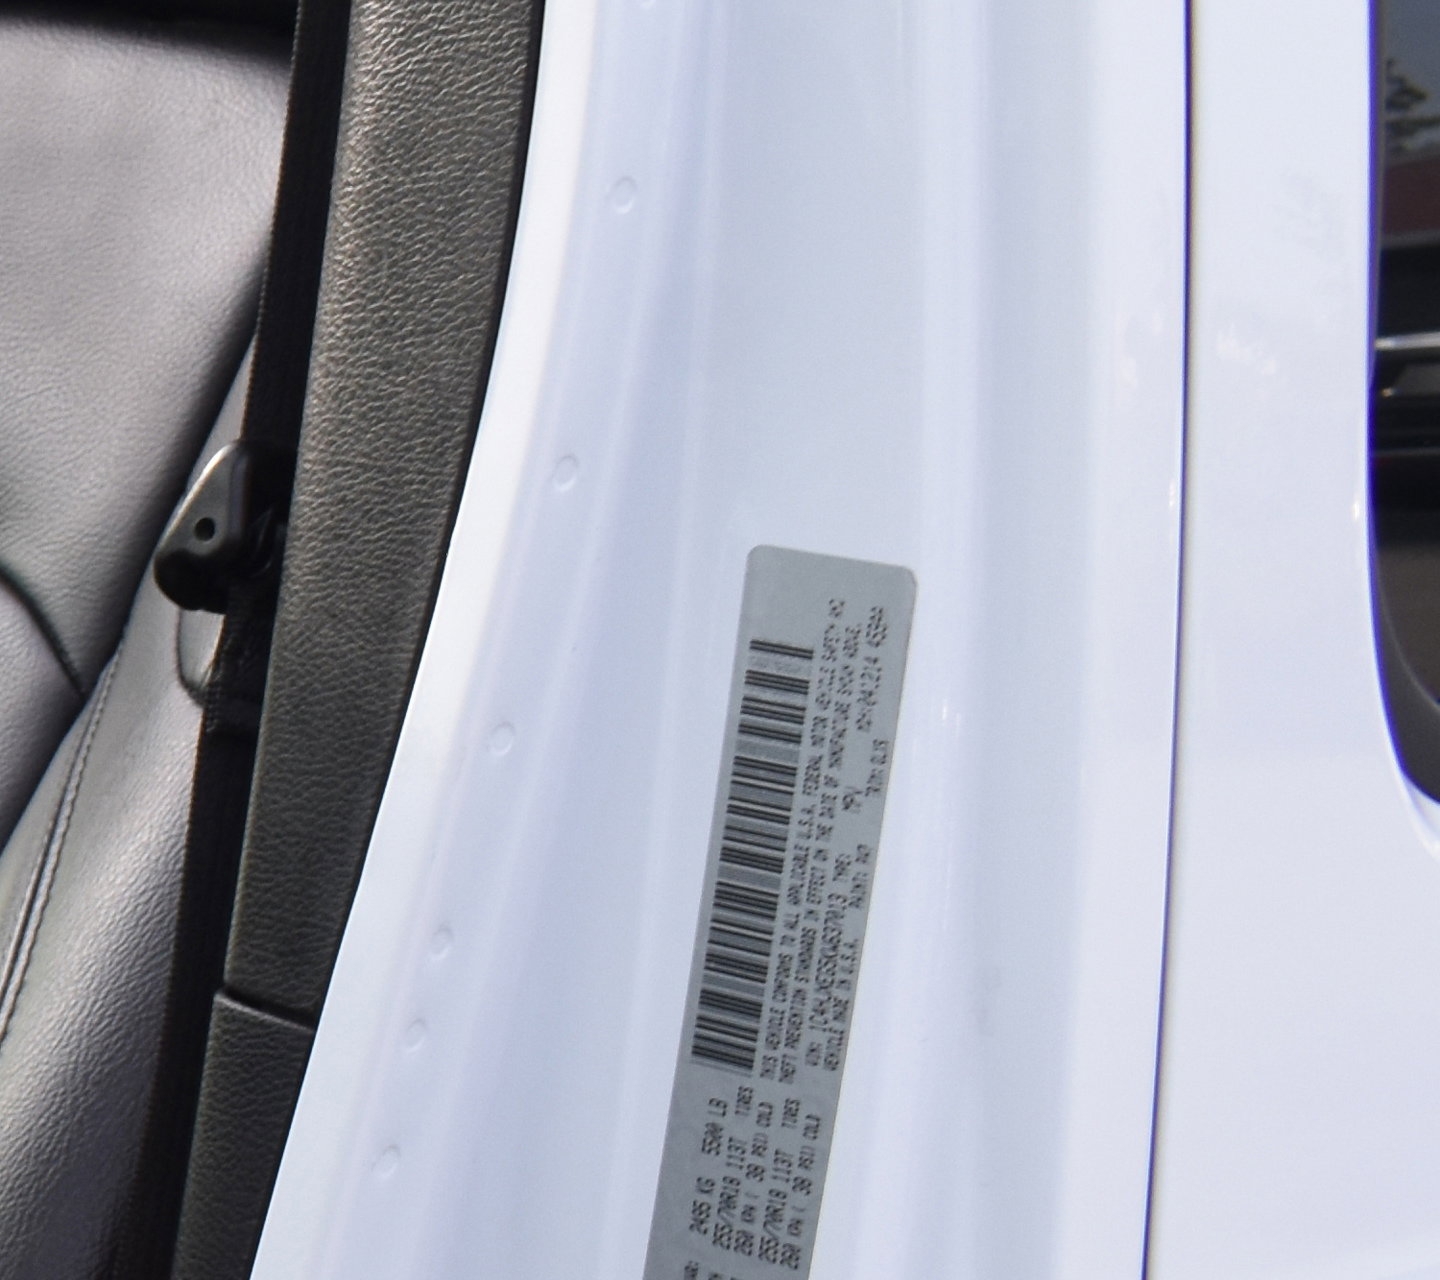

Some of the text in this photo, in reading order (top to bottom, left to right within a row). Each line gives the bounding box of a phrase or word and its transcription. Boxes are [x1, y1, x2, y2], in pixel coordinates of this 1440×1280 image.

[814, 666, 835, 710] VEHICLE
[810, 715, 828, 747] MOTOR
[801, 754, 823, 796] FEDERAL
[823, 774, 839, 788] OF
[818, 793, 836, 819] DATE
[842, 790, 863, 812] MPV
[815, 823, 832, 842] THE
[812, 848, 828, 861] ON
[786, 844, 809, 905] APPLICABLE
[805, 866, 826, 905] EFFECT
[783, 912, 799, 930] ALL
[803, 909, 820, 921] IN
[779, 934, 796, 946] TO
[794, 926, 816, 983] STANDARDS
[838, 938, 858, 974] U.S.A.
[771, 952, 793, 1003] CONFORMS
[835, 978, 851, 991] IN
[783, 988, 807, 1050] PREVENTION
[832, 996, 849, 1023] MADE
[764, 1007, 785, 1050] VEHICLE
[760, 1054, 777, 1078] THIS
[823, 1026, 844, 1072] VEHICLE
[778, 1053, 796, 1083] THEFT
[708, 1097, 728, 1117] LB
[734, 1086, 752, 1115] TIRES
[780, 1098, 800, 1128] TIRES
[700, 1122, 724, 1156] 5500
[725, 1136, 747, 1170] 113T
[733, 1230, 755, 1256] 260
[744, 1163, 765, 1182] 38
[755, 1101, 773, 1128] COLD
[770, 1148, 794, 1183] 113T
[696, 1176, 715, 1195] KG
[779, 1242, 801, 1270] 260
[791, 1176, 812, 1195] 38
[802, 1114, 820, 1141] COLD
[688, 1200, 711, 1236] 2495
[712, 1175, 741, 1250] 255/70R18
[757, 1188, 787, 1264] 255/70R18
